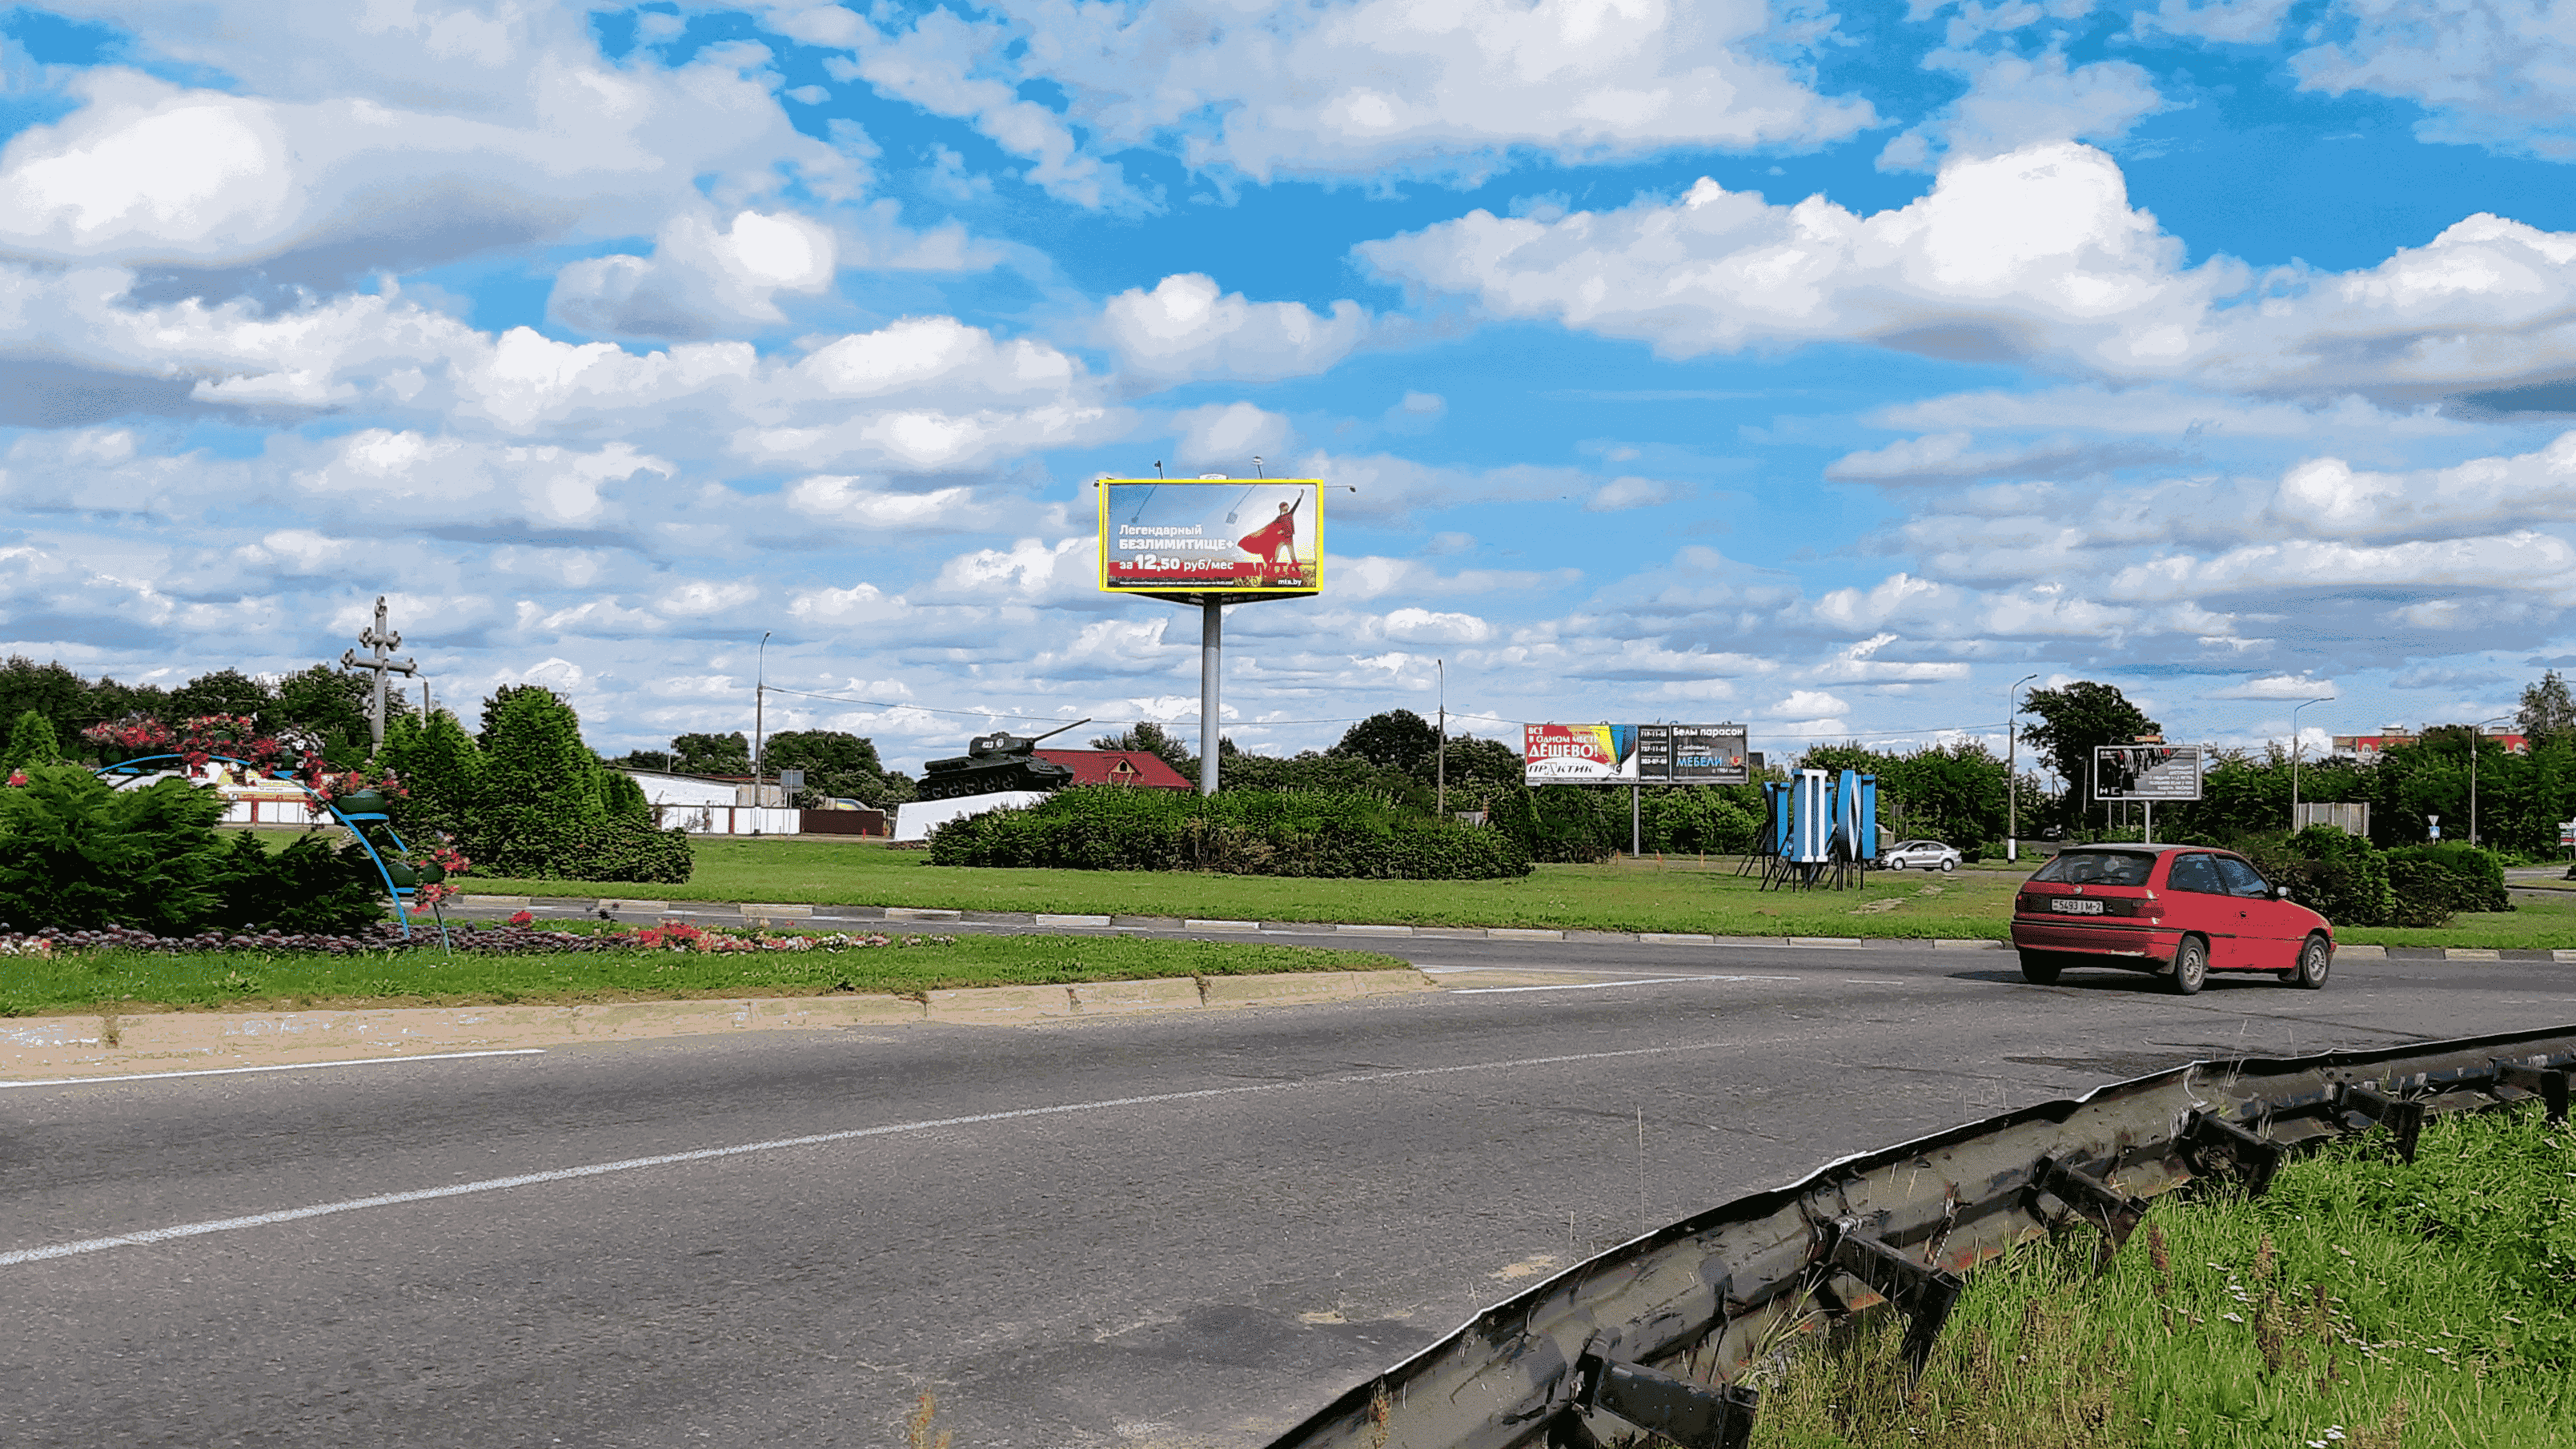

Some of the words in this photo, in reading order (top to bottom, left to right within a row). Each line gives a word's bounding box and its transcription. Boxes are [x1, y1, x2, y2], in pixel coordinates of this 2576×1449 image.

[1119, 524, 1202, 537] Легендарный
[1119, 539, 1234, 551] БЕЗЛИМИТИЩЕ+
[1135, 554, 1180, 572] 12,50
[1184, 559, 1234, 572] руб/мес
[1673, 727, 1698, 736] Белы
[1700, 729, 1743, 738] парасон
[1528, 742, 1599, 757] ДЁШЕВО!
[1528, 762, 1594, 776] ПРАКТИК
[2060, 901, 2078, 909] 5493
